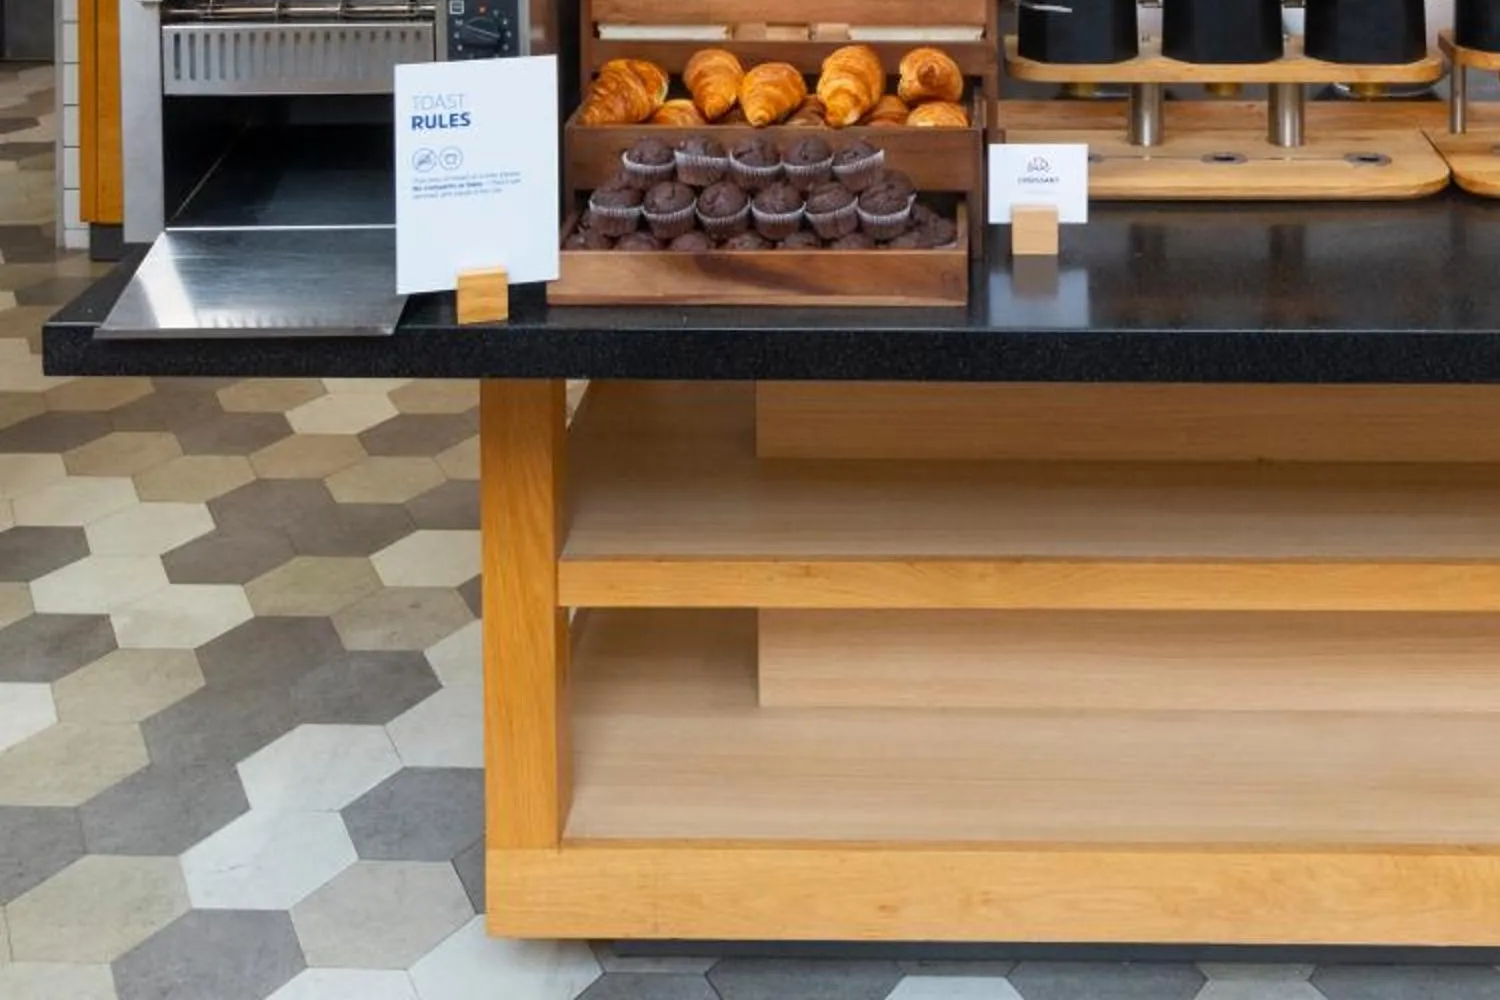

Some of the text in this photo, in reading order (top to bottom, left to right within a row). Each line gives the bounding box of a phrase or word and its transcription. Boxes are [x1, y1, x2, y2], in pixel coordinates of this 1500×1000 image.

[411, 93, 465, 111] TOAST
[411, 112, 472, 131] RULES
[1017, 177, 1060, 185] CROISSANT
